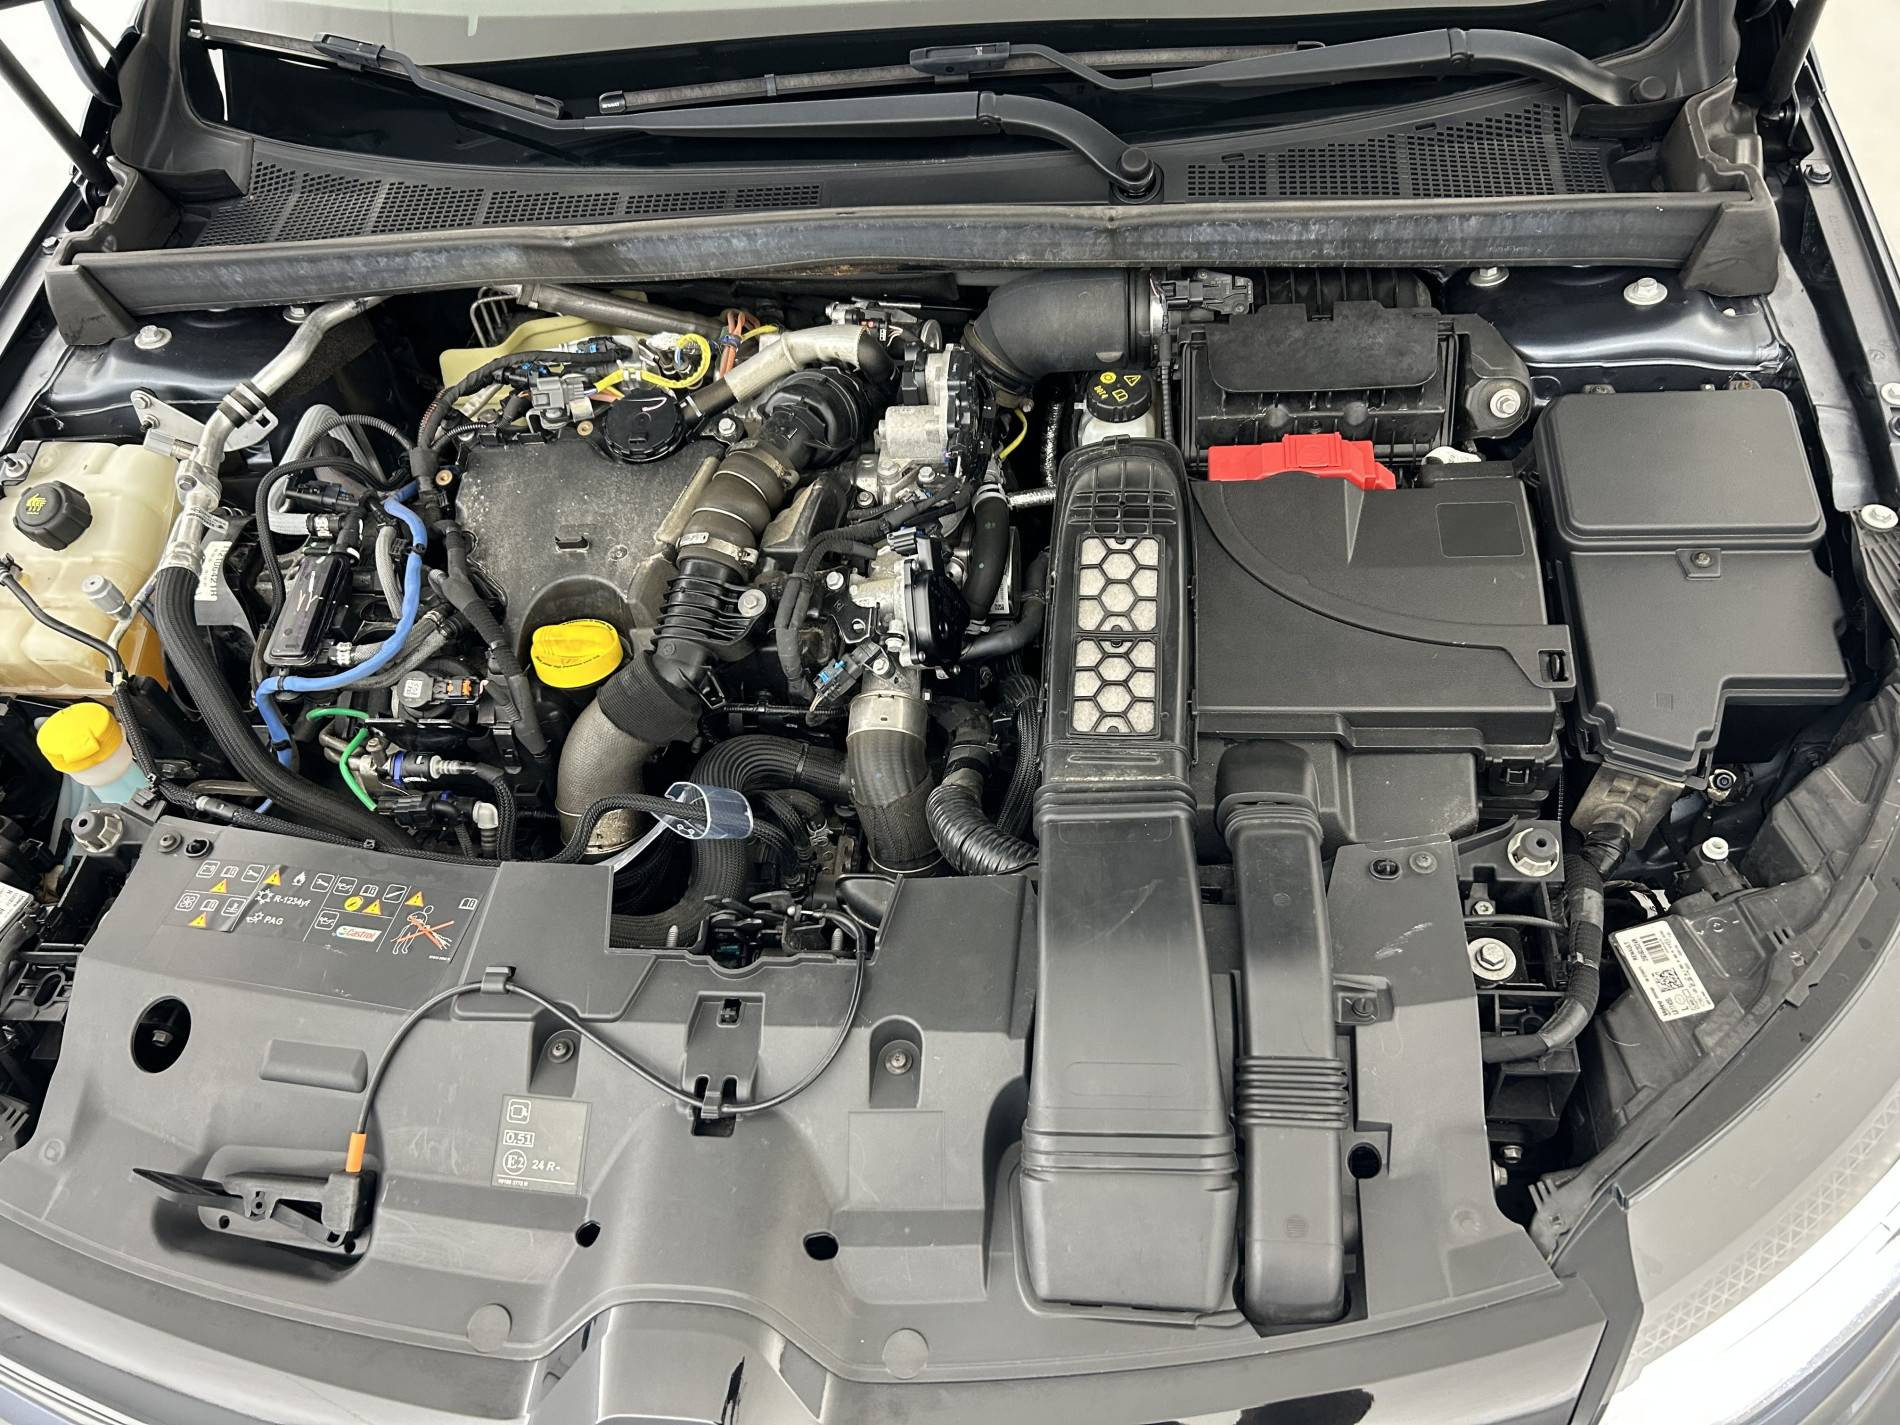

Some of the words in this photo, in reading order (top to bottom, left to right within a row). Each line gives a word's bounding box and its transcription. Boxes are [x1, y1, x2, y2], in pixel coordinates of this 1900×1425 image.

[273, 894, 311, 909] R-1234yf
[263, 915, 284, 925] PAG
[346, 928, 376, 941] Castrol
[507, 1155, 524, 1168] E2
[531, 1159, 545, 1170] 24
